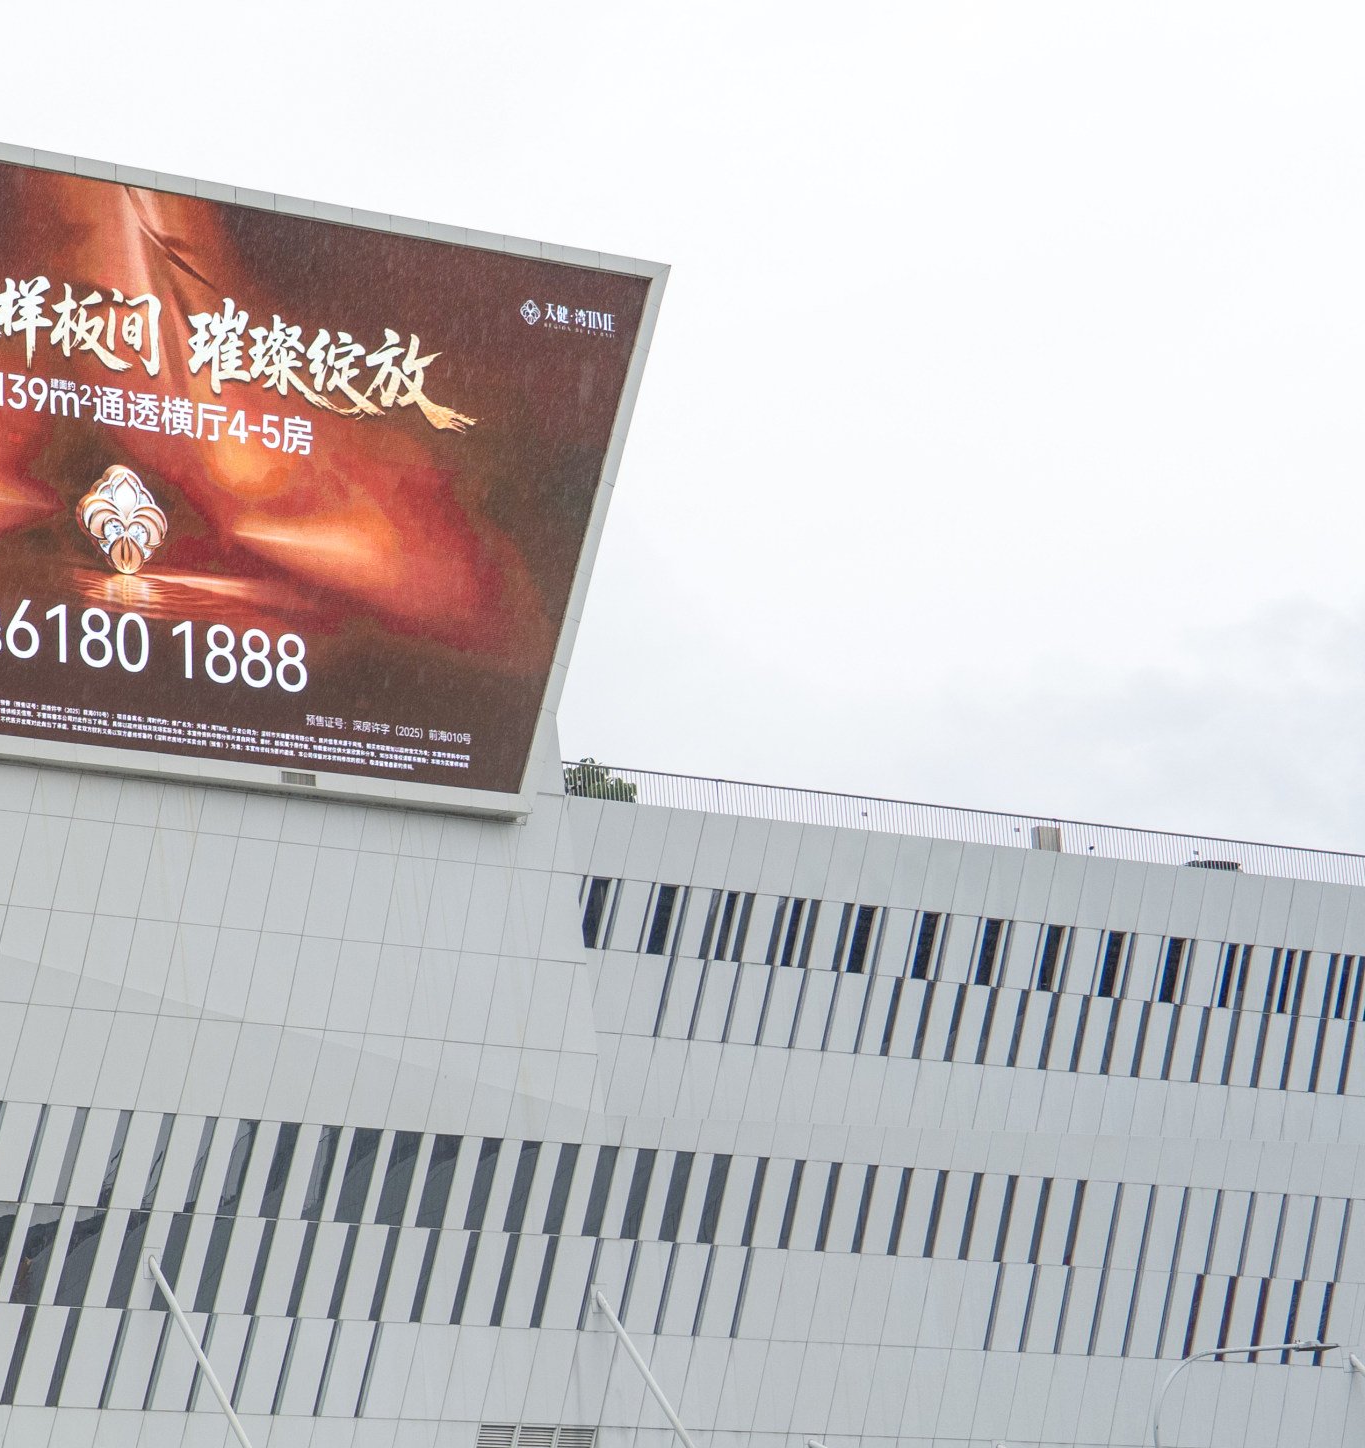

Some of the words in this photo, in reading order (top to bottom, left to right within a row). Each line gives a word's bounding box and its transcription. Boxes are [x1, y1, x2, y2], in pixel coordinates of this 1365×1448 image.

[187, 297, 478, 434] 璀璨绽放
[4, 599, 150, 673] 6180
[171, 620, 309, 694] 1888
